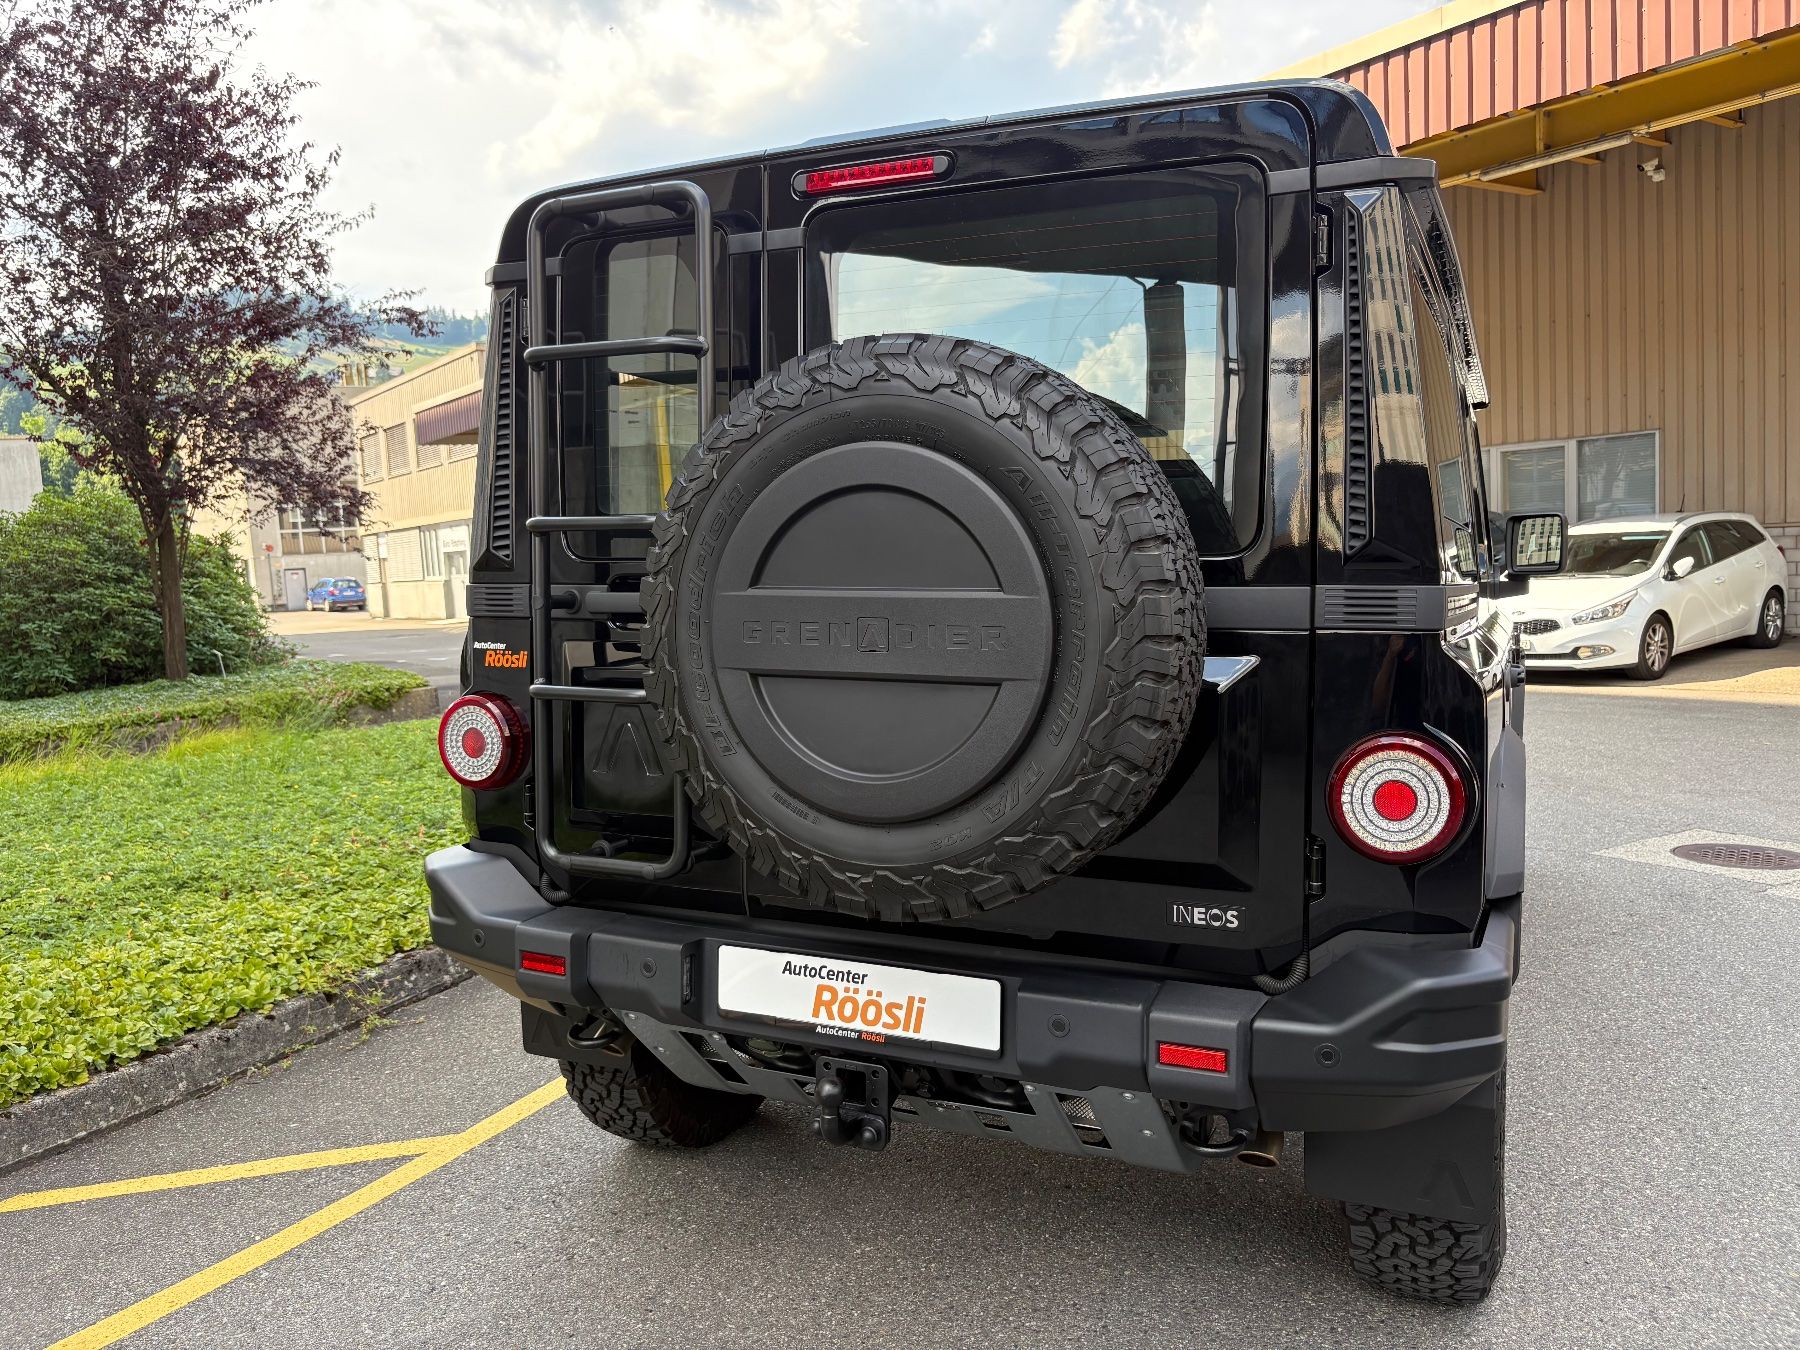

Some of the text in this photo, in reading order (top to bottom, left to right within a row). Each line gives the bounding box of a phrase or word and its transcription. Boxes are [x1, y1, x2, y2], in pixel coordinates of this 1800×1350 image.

[687, 483, 745, 757] BFGoodrich
[999, 465, 1087, 748] All-Terrain
[473, 641, 507, 650] AutoCenter
[742, 617, 1007, 654] GRENADIER
[485, 649, 528, 668] Röösli
[981, 760, 1045, 824] T/A
[1172, 904, 1239, 928] INEOS
[782, 960, 868, 984] AutoCenter
[811, 983, 927, 1034] Röösli
[815, 1025, 886, 1043] AutoCenter Röösli
